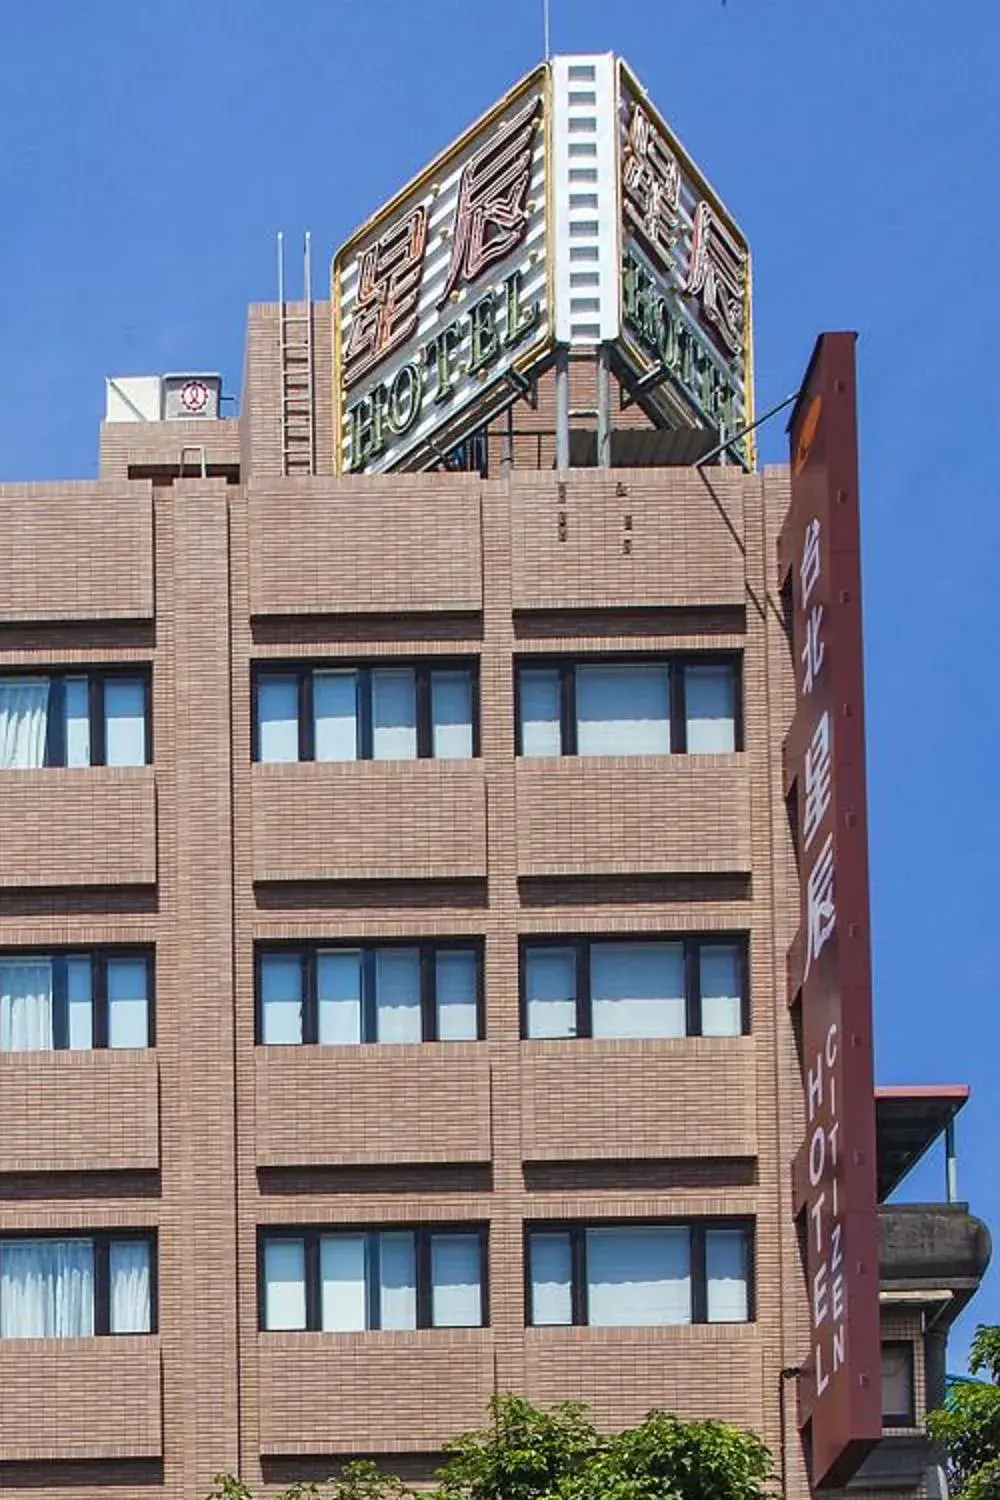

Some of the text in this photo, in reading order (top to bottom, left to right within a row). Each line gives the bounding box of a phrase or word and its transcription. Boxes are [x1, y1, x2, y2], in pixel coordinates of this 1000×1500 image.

[345, 268, 540, 470] HOTEL
[808, 1055, 828, 1396] HOTEL
[824, 1023, 845, 1372] CITIZEN
